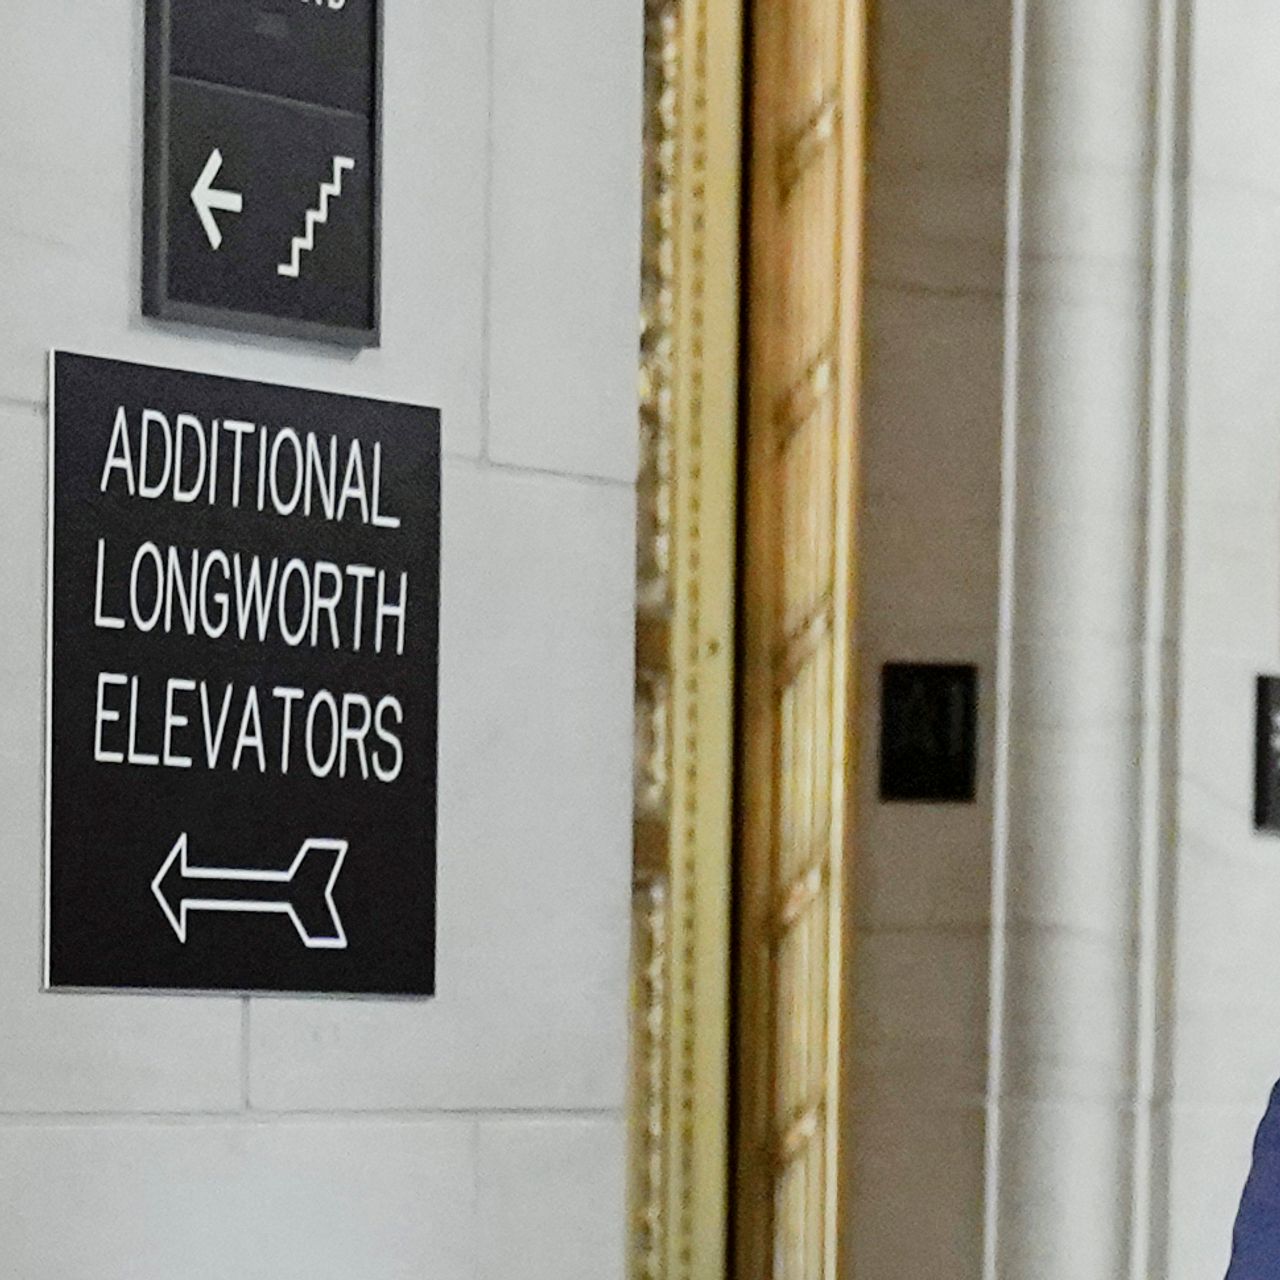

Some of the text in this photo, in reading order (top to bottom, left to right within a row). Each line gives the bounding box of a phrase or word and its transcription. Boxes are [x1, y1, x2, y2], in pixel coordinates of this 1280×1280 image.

[100, 405, 400, 528] ADDITIONAL
[94, 538, 407, 655] LONGWORTH
[94, 672, 403, 782] ELEVATORS
